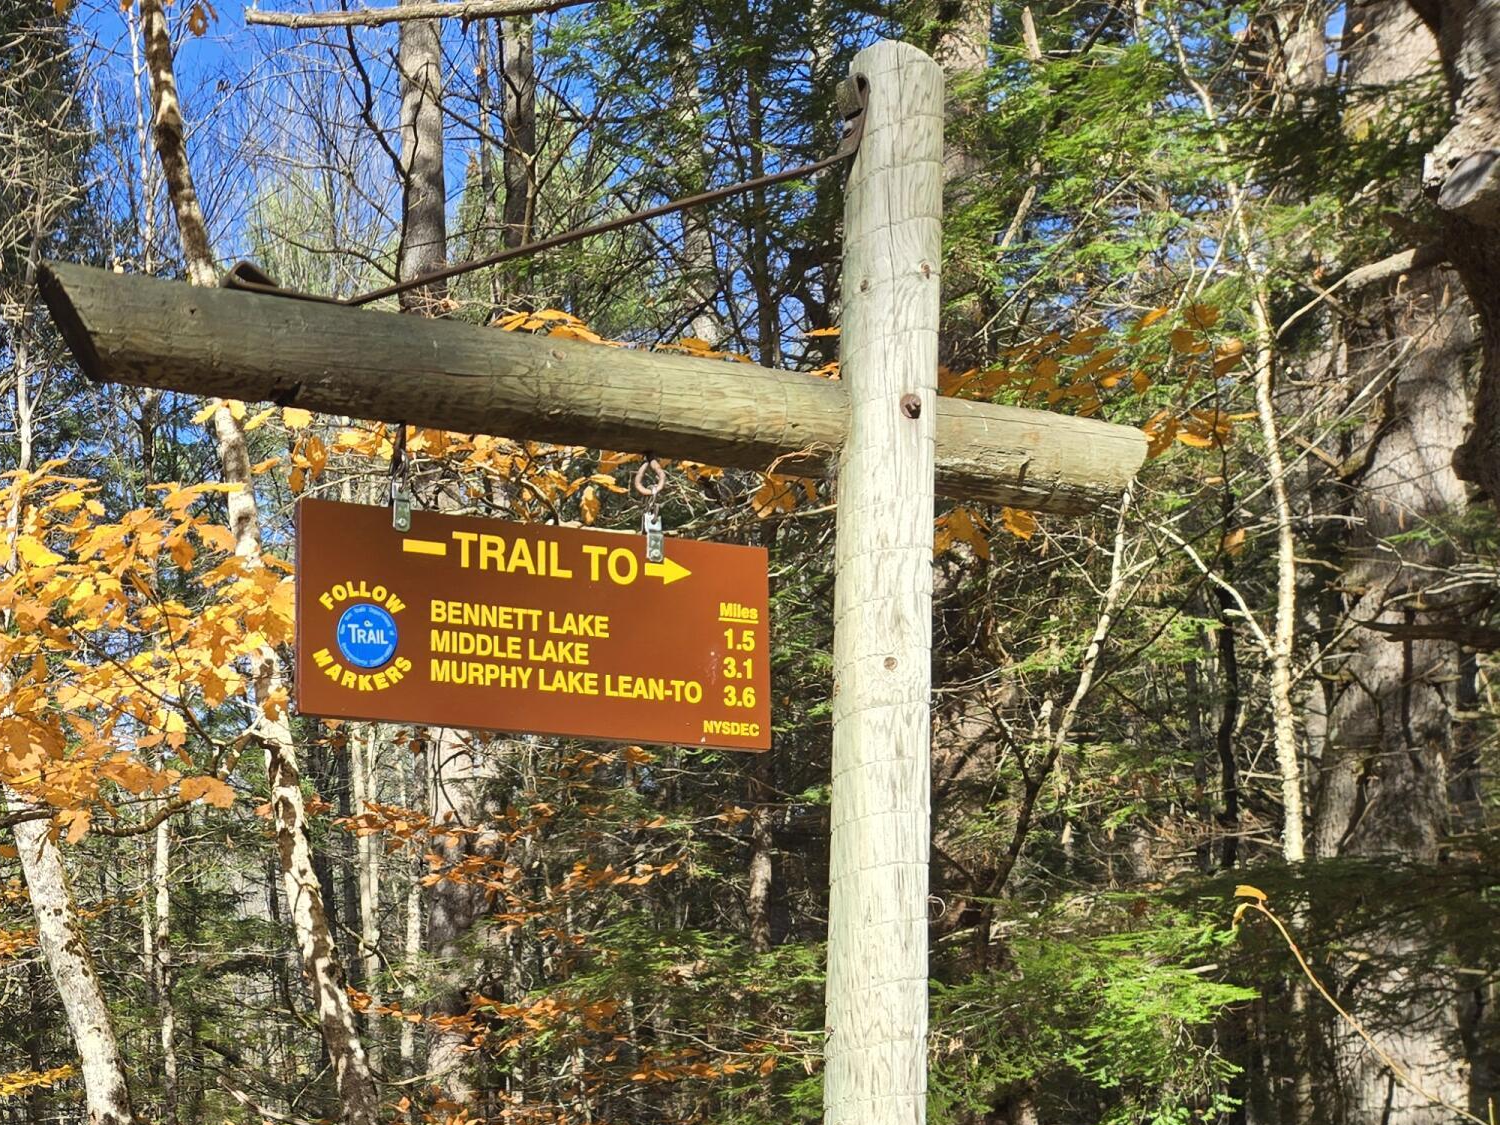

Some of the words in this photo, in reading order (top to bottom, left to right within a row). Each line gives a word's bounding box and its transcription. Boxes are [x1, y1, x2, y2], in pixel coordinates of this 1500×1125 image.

[451, 530, 573, 579] TRAIL
[582, 545, 639, 586] TO
[319, 580, 406, 614] FOLLOW
[719, 602, 759, 620] Miles
[430, 599, 543, 632] BENNETT
[548, 611, 610, 639] LAKE
[347, 623, 389, 645] TRAIL
[430, 629, 522, 660] MIDDLE
[528, 638, 590, 666] LAKE
[723, 627, 756, 652] 1.5
[312, 647, 412, 692] MARKERS
[430, 658, 533, 690] MURPHY
[538, 668, 599, 696] LAKE
[605, 674, 703, 704] LEAN-TO
[722, 656, 753, 680] 3.1
[723, 684, 756, 709] 3.6
[703, 719, 760, 738] NYSDEC
